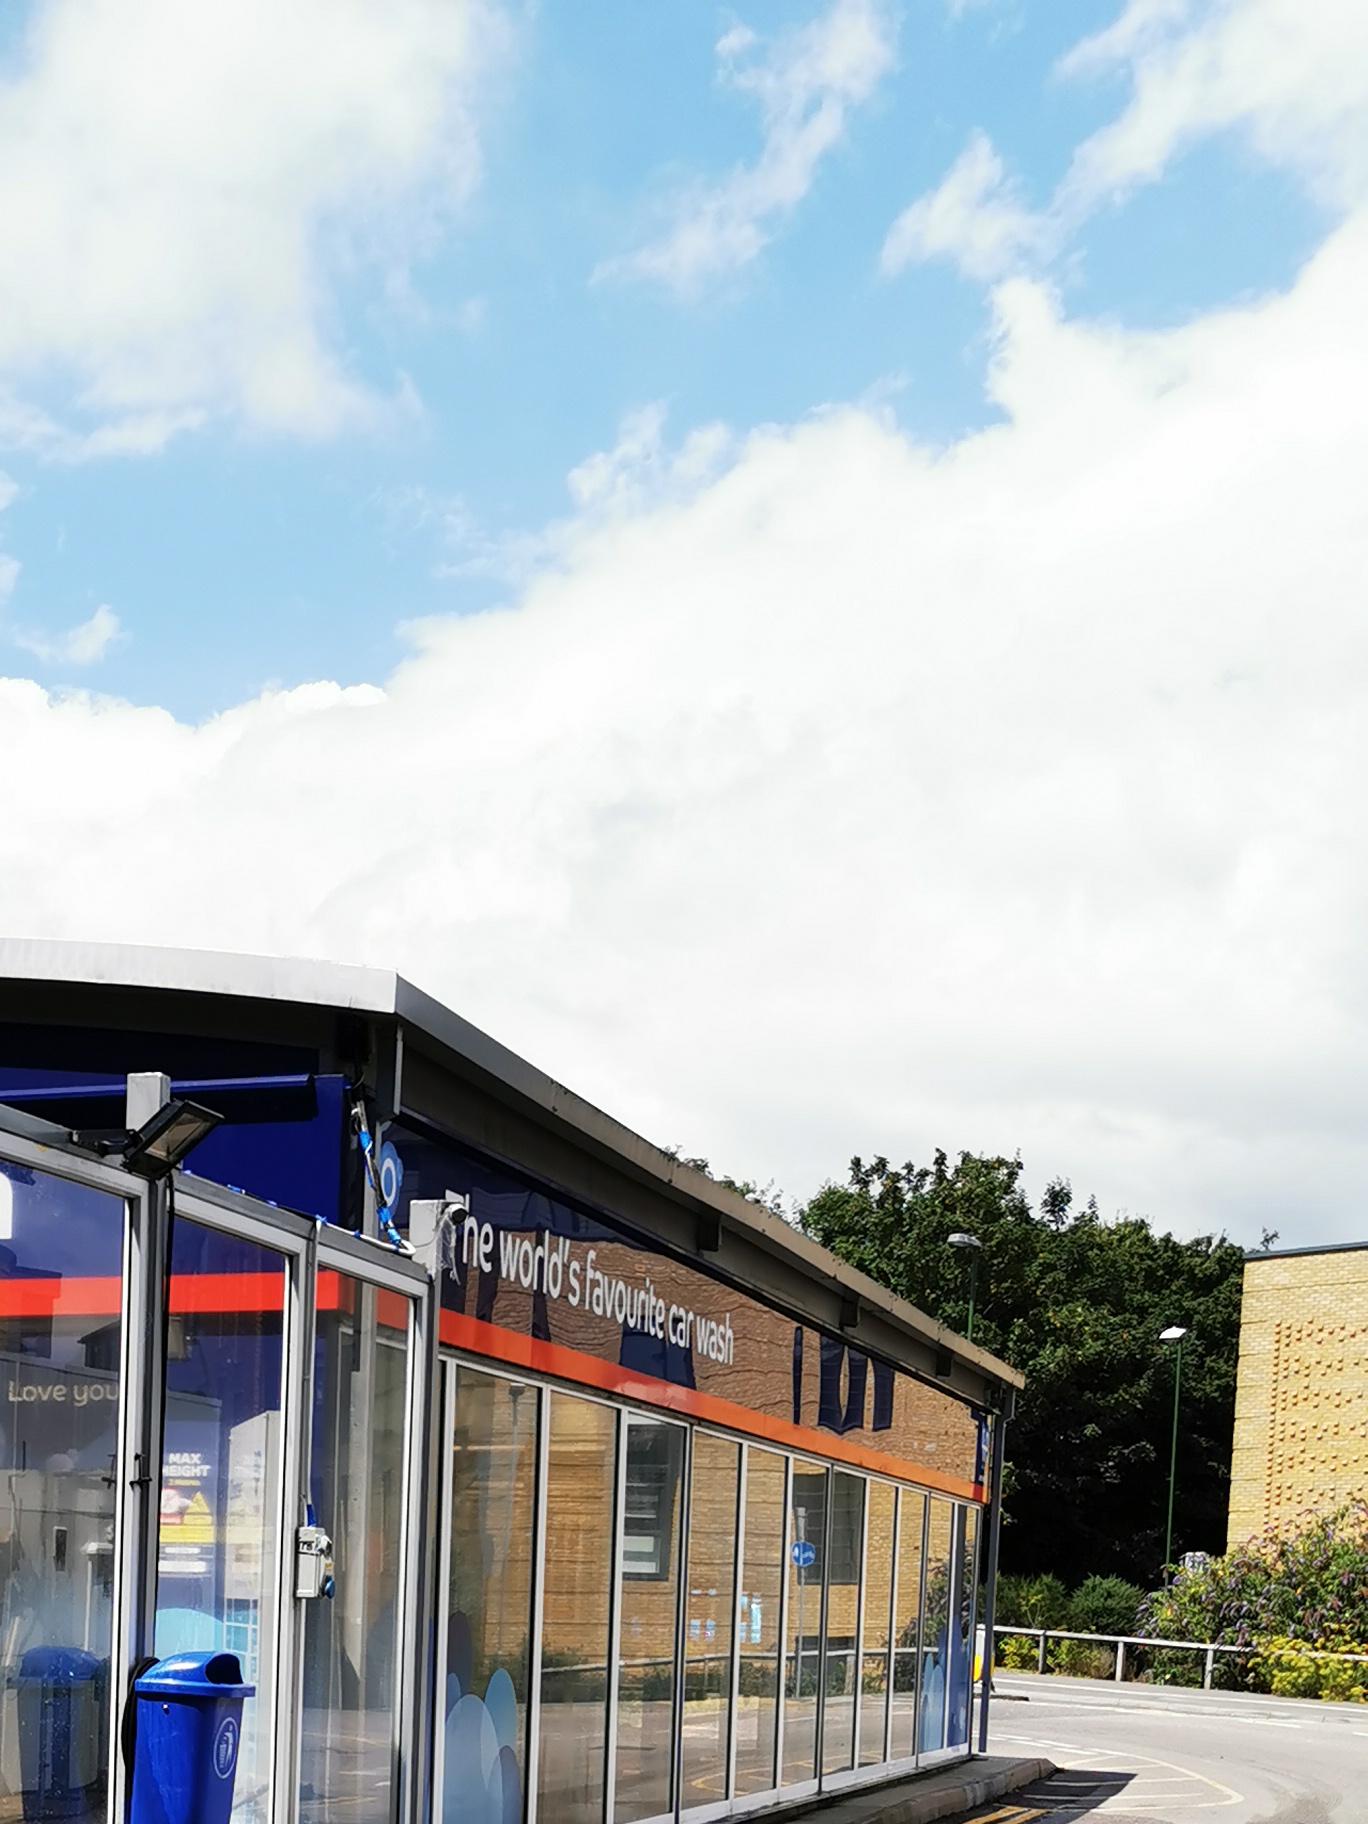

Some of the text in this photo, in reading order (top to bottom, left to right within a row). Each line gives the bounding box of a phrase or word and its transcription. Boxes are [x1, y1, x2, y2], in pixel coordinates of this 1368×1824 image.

[499, 1229, 581, 1307] world's
[585, 1249, 666, 1341] favourite
[667, 1301, 695, 1350] car
[695, 1312, 734, 1366] wash
[8, 1380, 120, 1407] Love you
[169, 1453, 201, 1464] MAX
